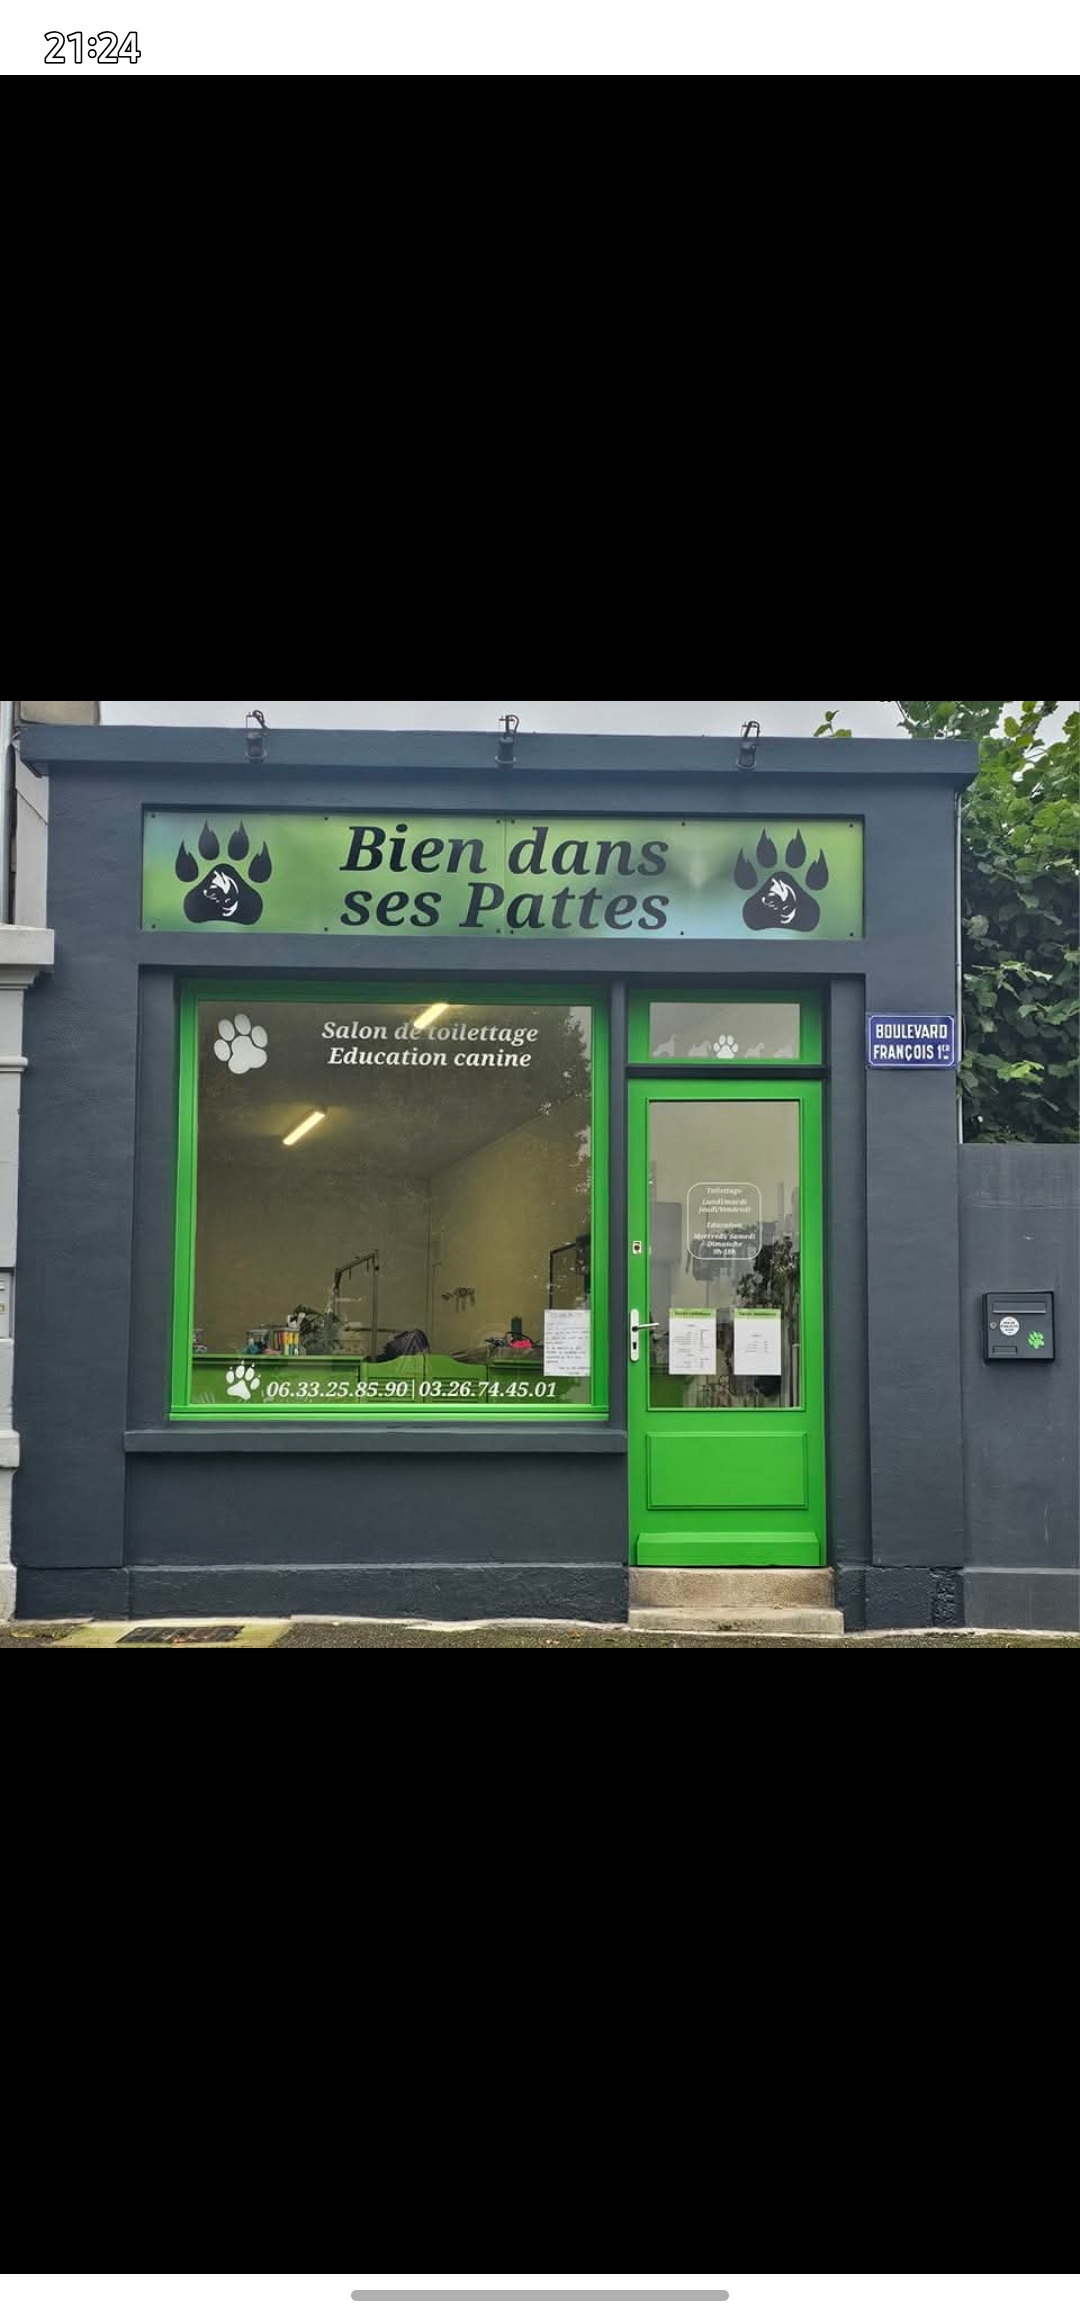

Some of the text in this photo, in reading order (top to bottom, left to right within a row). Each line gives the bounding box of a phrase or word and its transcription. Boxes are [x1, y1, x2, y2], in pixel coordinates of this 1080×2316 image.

[339, 823, 669, 876] Bien dans
[340, 882, 670, 930] ses Pattes
[321, 1021, 539, 1047] Salon de toilettage
[875, 1024, 948, 1039] BOULEVARD
[327, 1047, 532, 1067] Education canine
[873, 1044, 934, 1061] FRANÇOIS
[266, 1381, 556, 1398] 06.33.25.85.90 03.26.74.45.01
